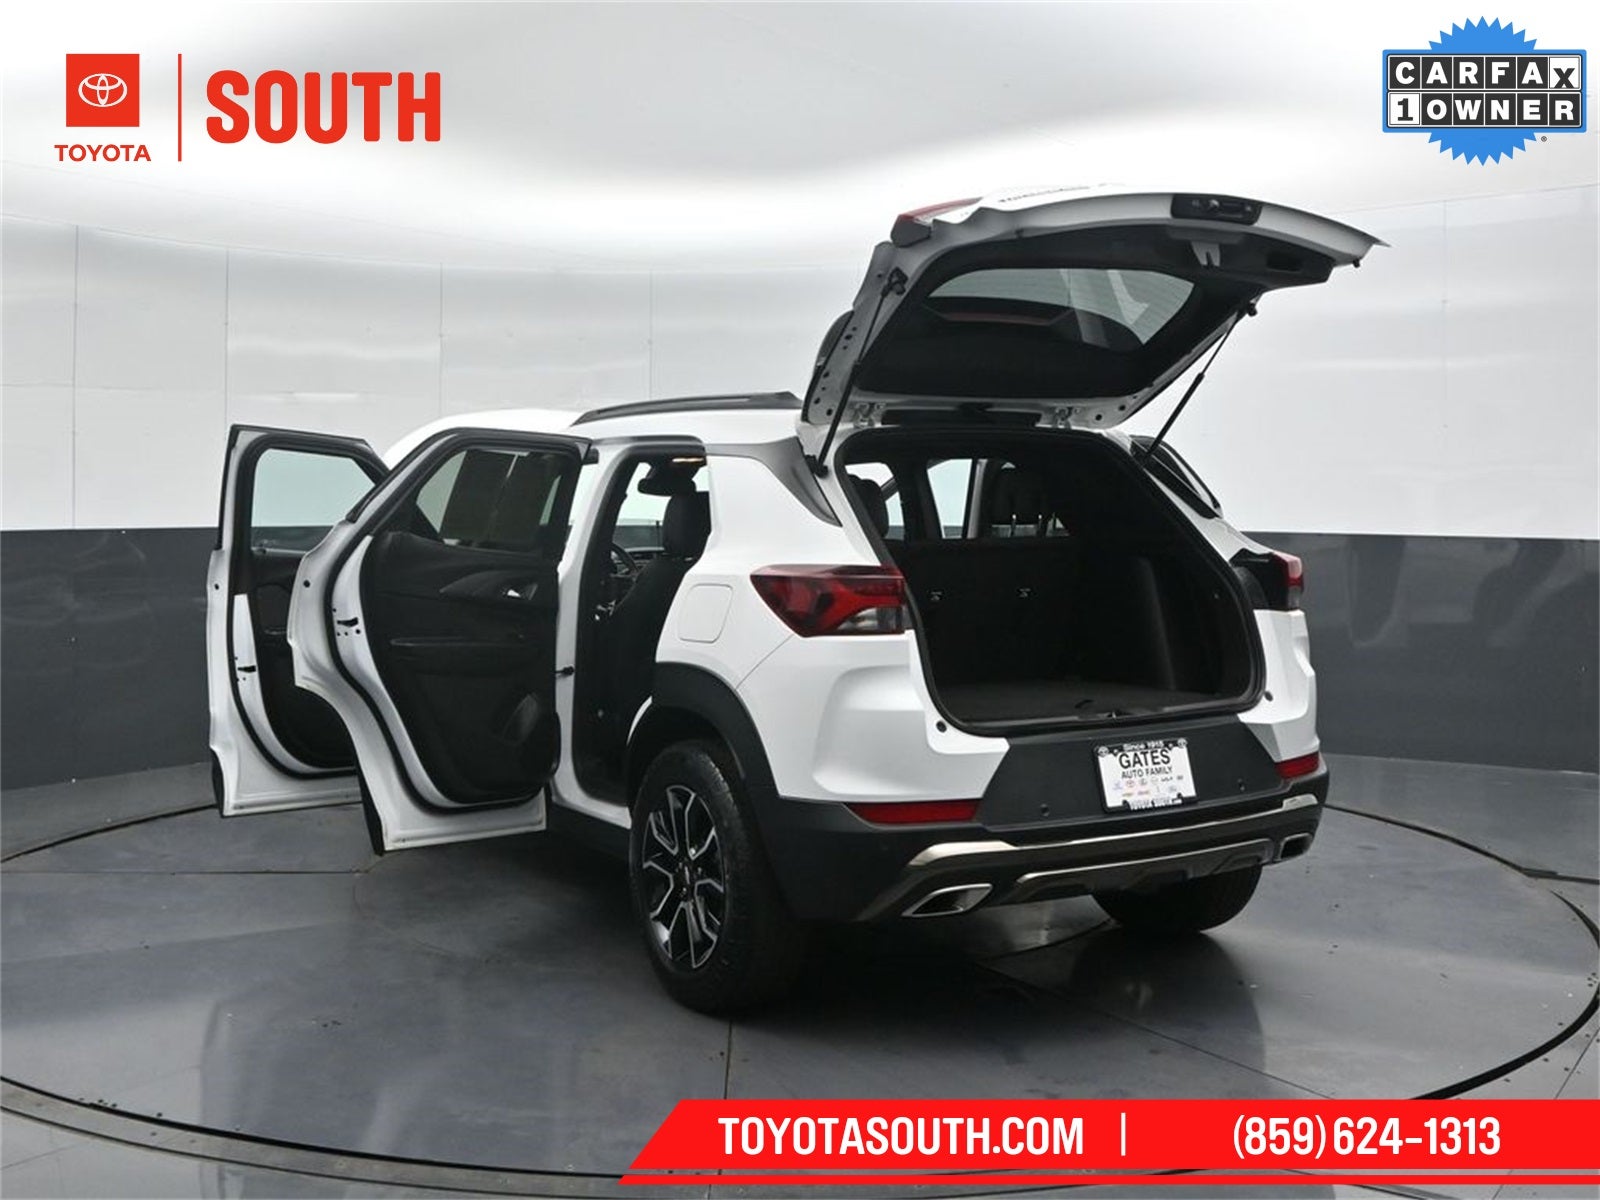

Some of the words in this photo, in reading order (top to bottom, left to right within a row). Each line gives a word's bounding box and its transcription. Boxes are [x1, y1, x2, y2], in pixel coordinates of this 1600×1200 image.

[1118, 748, 1171, 769] GATES
[1121, 769, 1144, 779] AUTO
[1145, 766, 1173, 776] FAMILY
